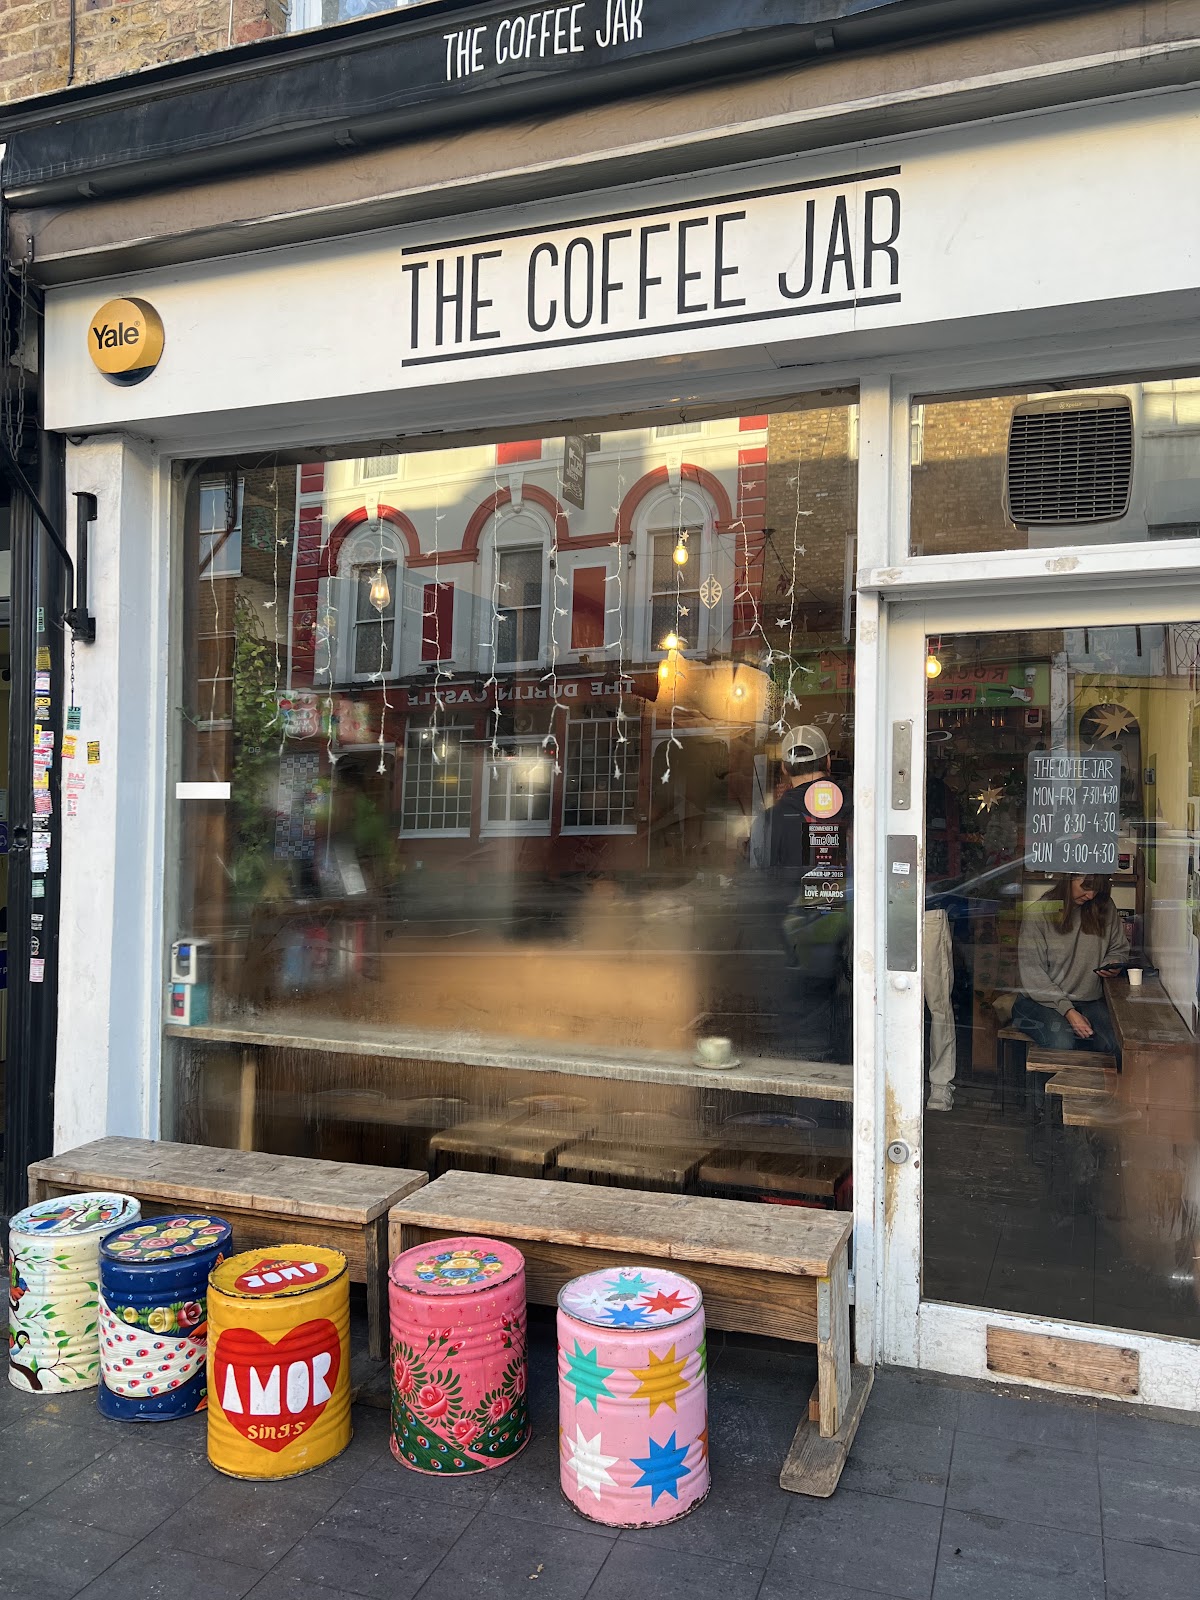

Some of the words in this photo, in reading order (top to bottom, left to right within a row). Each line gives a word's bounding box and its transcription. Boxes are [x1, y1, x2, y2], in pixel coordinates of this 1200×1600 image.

[443, 26, 487, 81] THE
[496, 3, 585, 65] COFFEE
[595, 0, 643, 48] JAR
[402, 250, 502, 349] THE
[528, 211, 746, 333] COFFEE
[779, 188, 901, 299] JAR
[93, 322, 139, 350] Yale
[1034, 759, 1055, 778] THE
[1058, 759, 1090, 778] COFFEE
[1091, 759, 1114, 779] JAR
[1032, 813, 1054, 834] SAT
[1031, 841, 1053, 863] SUN
[819, 890, 844, 898] AWARDS
[242, 1262, 318, 1288] AMOR
[222, 1352, 332, 1415] AMOR
